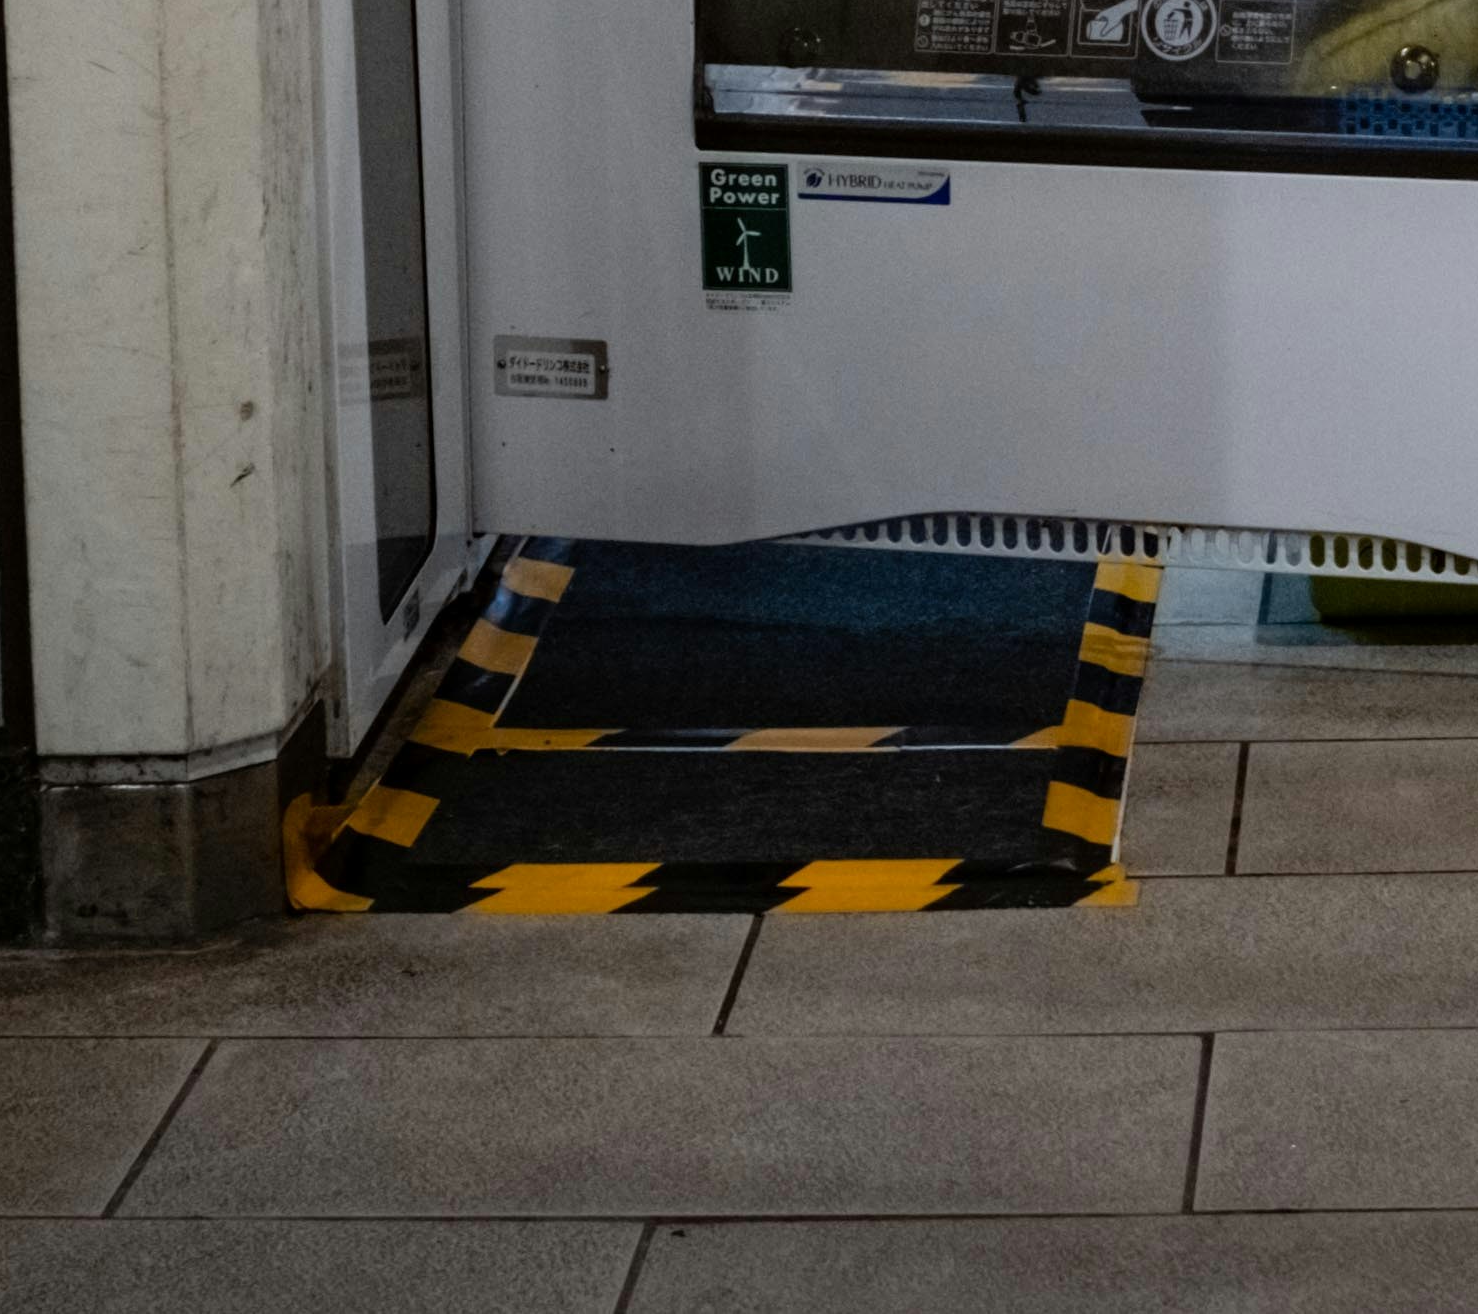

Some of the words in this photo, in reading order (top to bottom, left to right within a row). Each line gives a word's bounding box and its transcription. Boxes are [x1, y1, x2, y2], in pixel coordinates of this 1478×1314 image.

[709, 168, 779, 188] Green
[827, 174, 883, 189] HYBRID
[708, 187, 781, 206] Power
[715, 266, 780, 284] WIND
